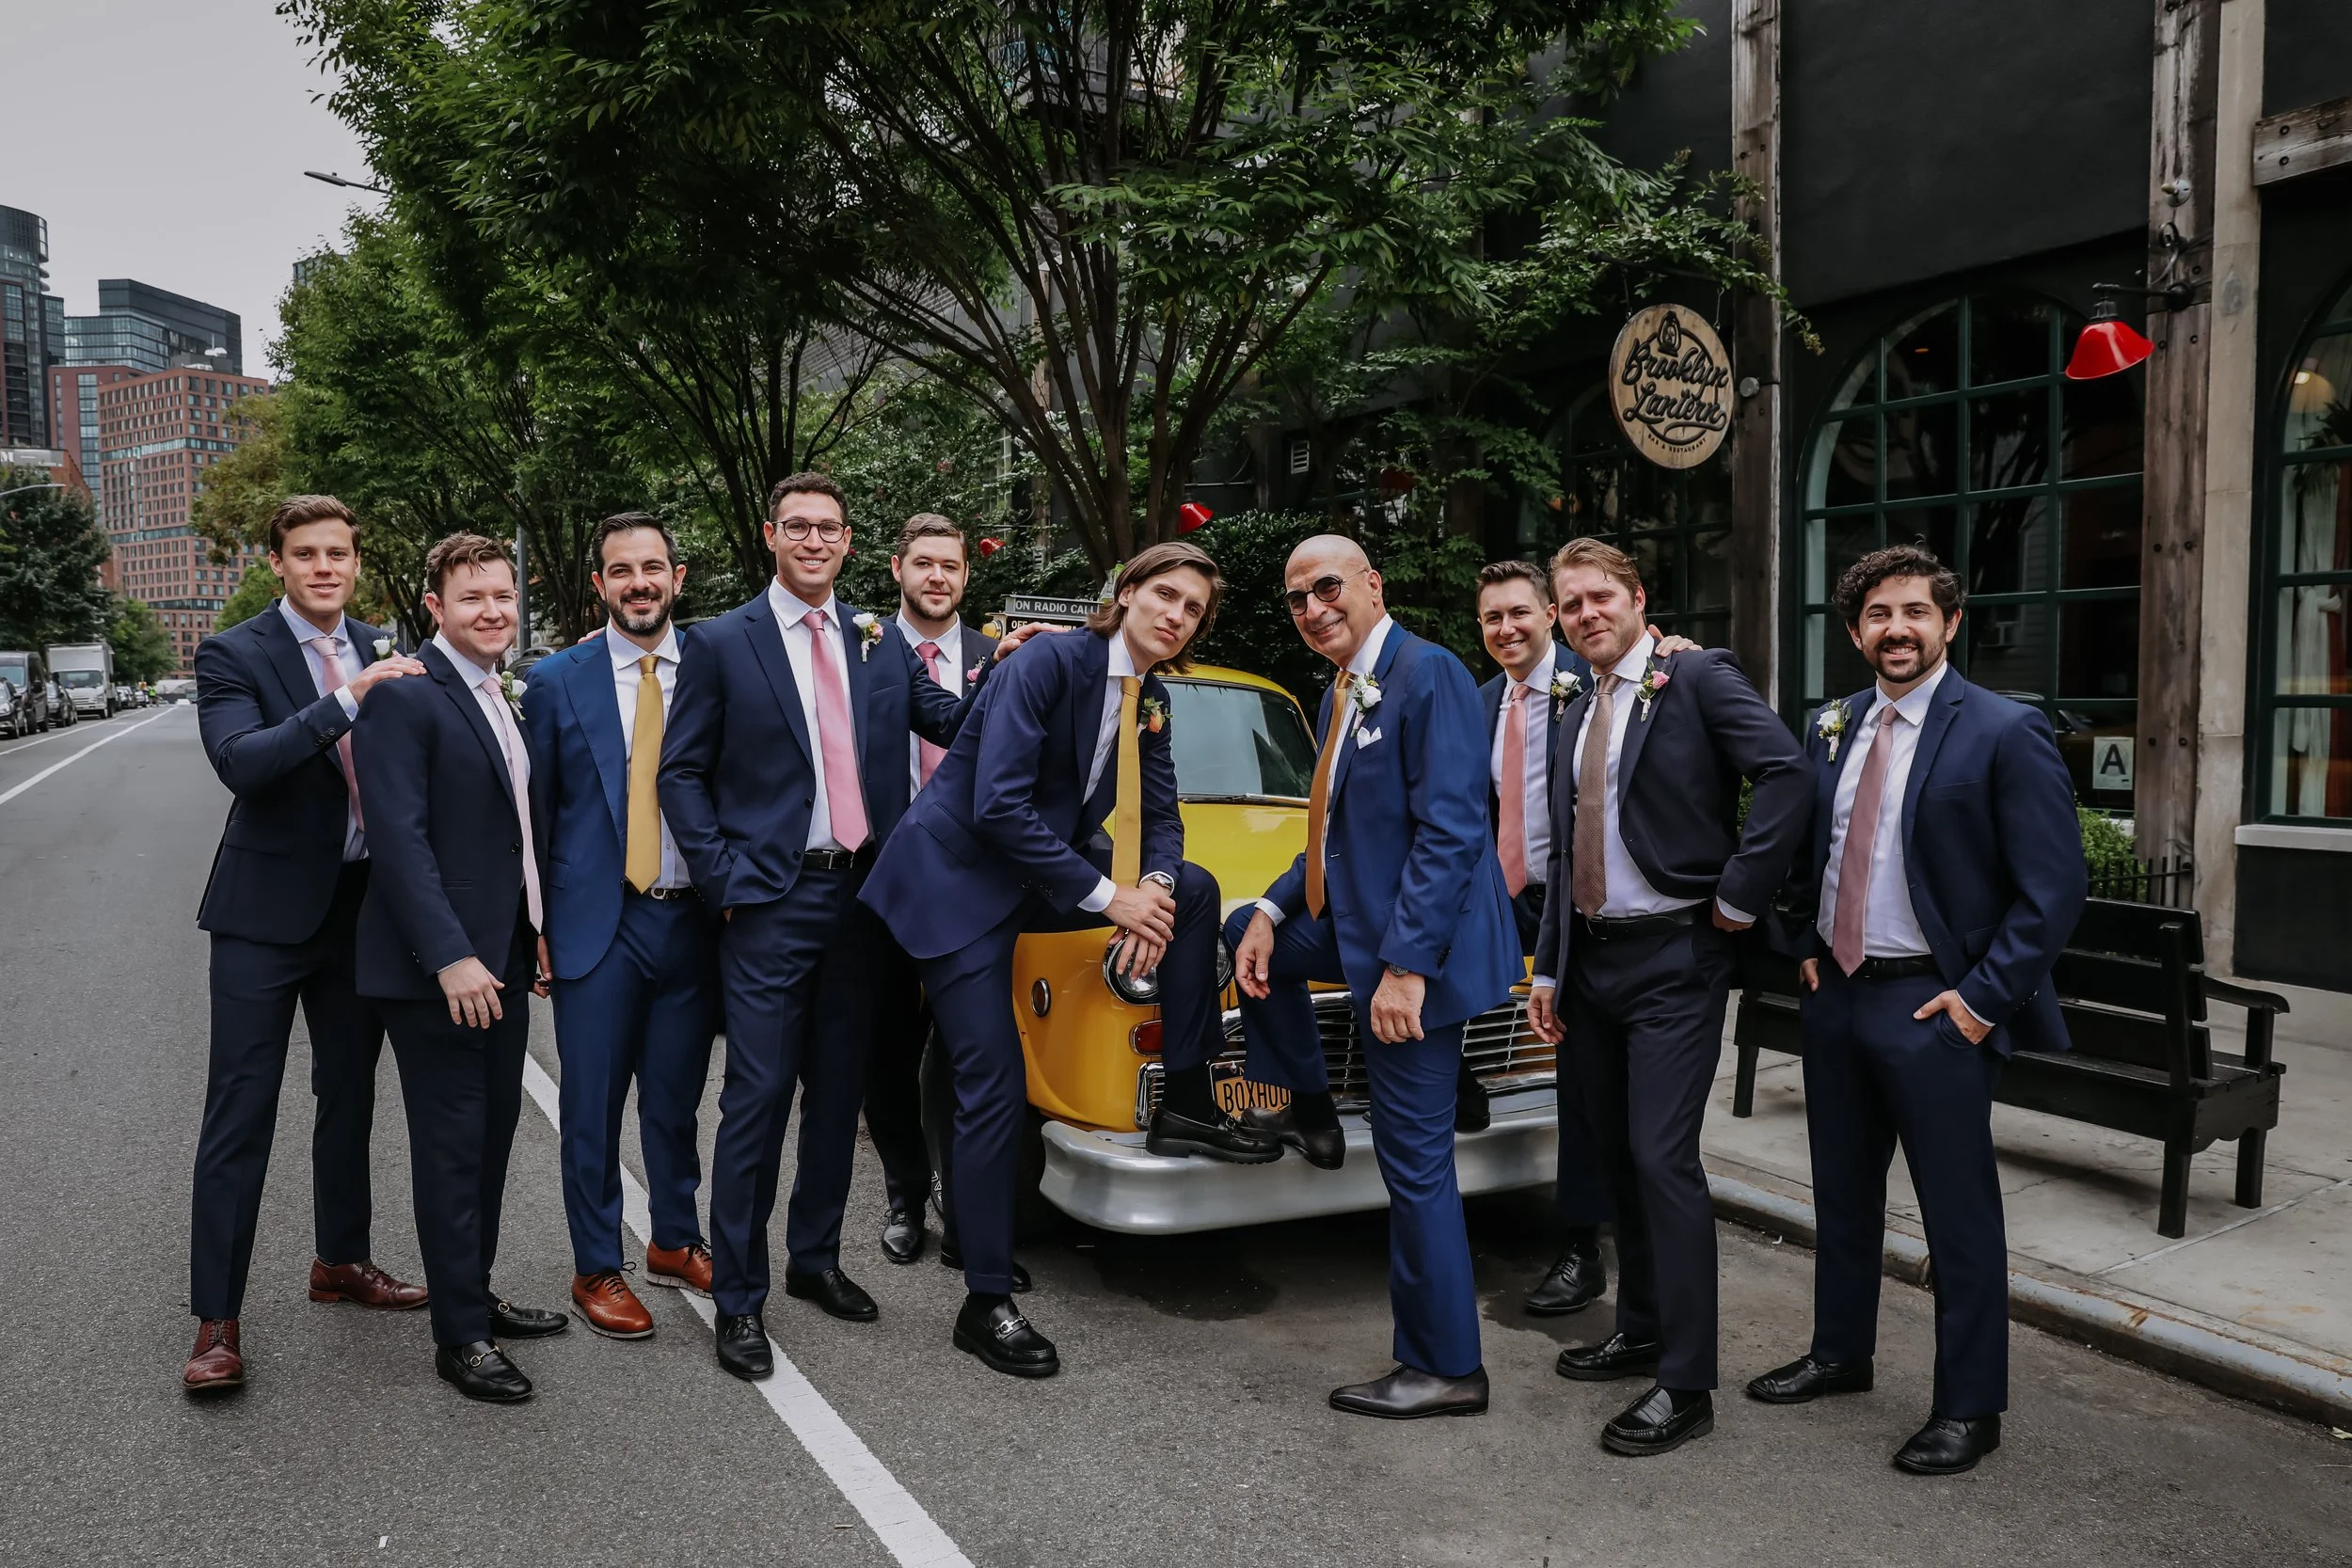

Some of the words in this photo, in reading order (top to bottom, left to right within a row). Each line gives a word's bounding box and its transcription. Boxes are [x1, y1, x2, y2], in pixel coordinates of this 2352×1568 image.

[1622, 338, 1729, 401] Brooklyn
[1623, 381, 1727, 432] Lantern
[1015, 600, 1030, 610] ON
[1034, 602, 1067, 613] RADIO
[2100, 743, 2126, 775] A
